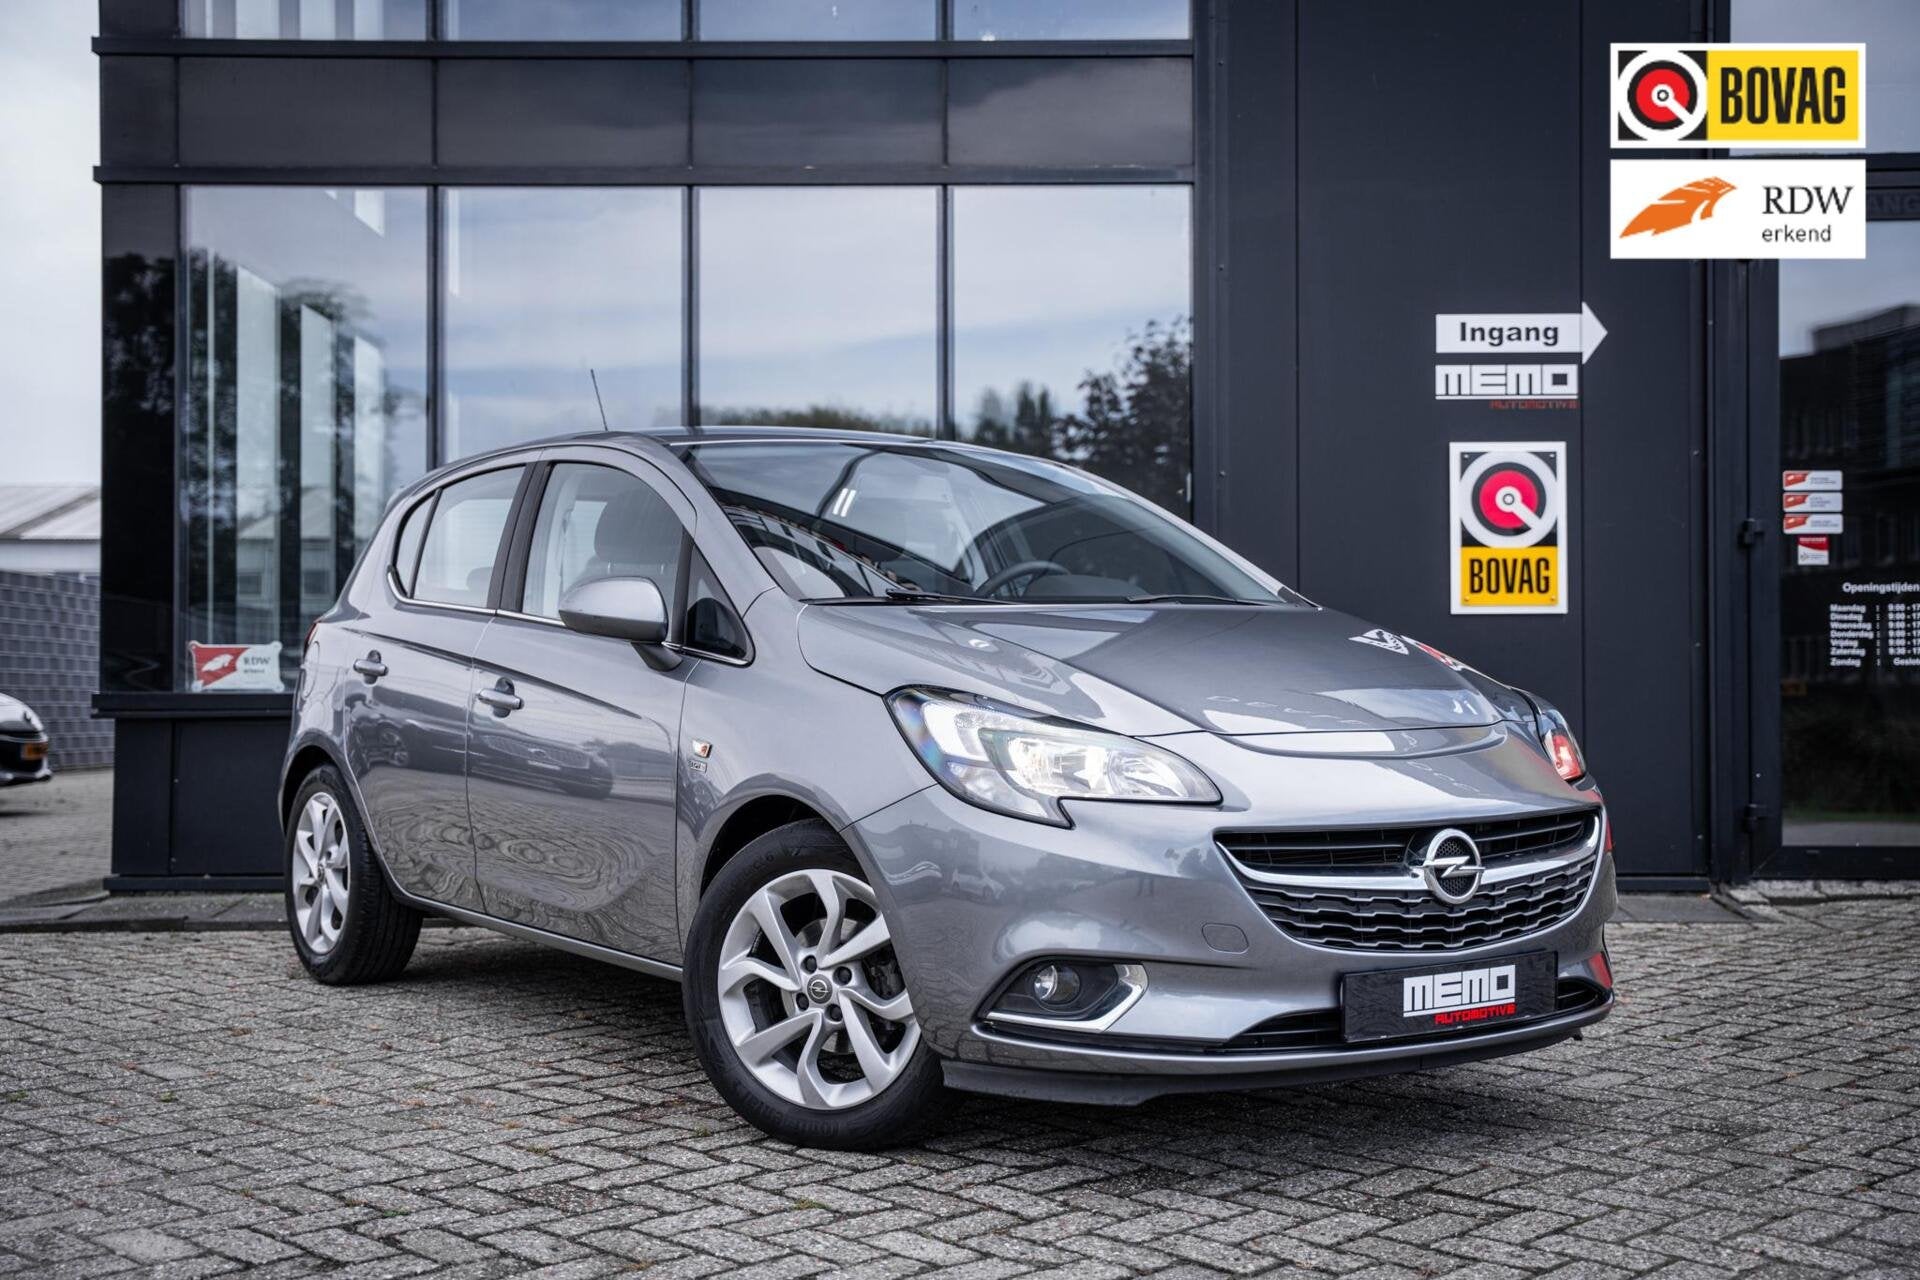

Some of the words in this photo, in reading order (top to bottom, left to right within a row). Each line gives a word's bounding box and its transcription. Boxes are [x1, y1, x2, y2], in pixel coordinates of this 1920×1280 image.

[1460, 322, 1559, 347] Ingang
[1435, 364, 1578, 396] MEMO
[1469, 557, 1550, 594] BOVAG
[1842, 581, 1920, 594] Openingstijden
[244, 656, 271, 665] RDW
[1403, 964, 1516, 1012] MEMO
[1434, 1002, 1517, 1025] AUTOMOTIVE
